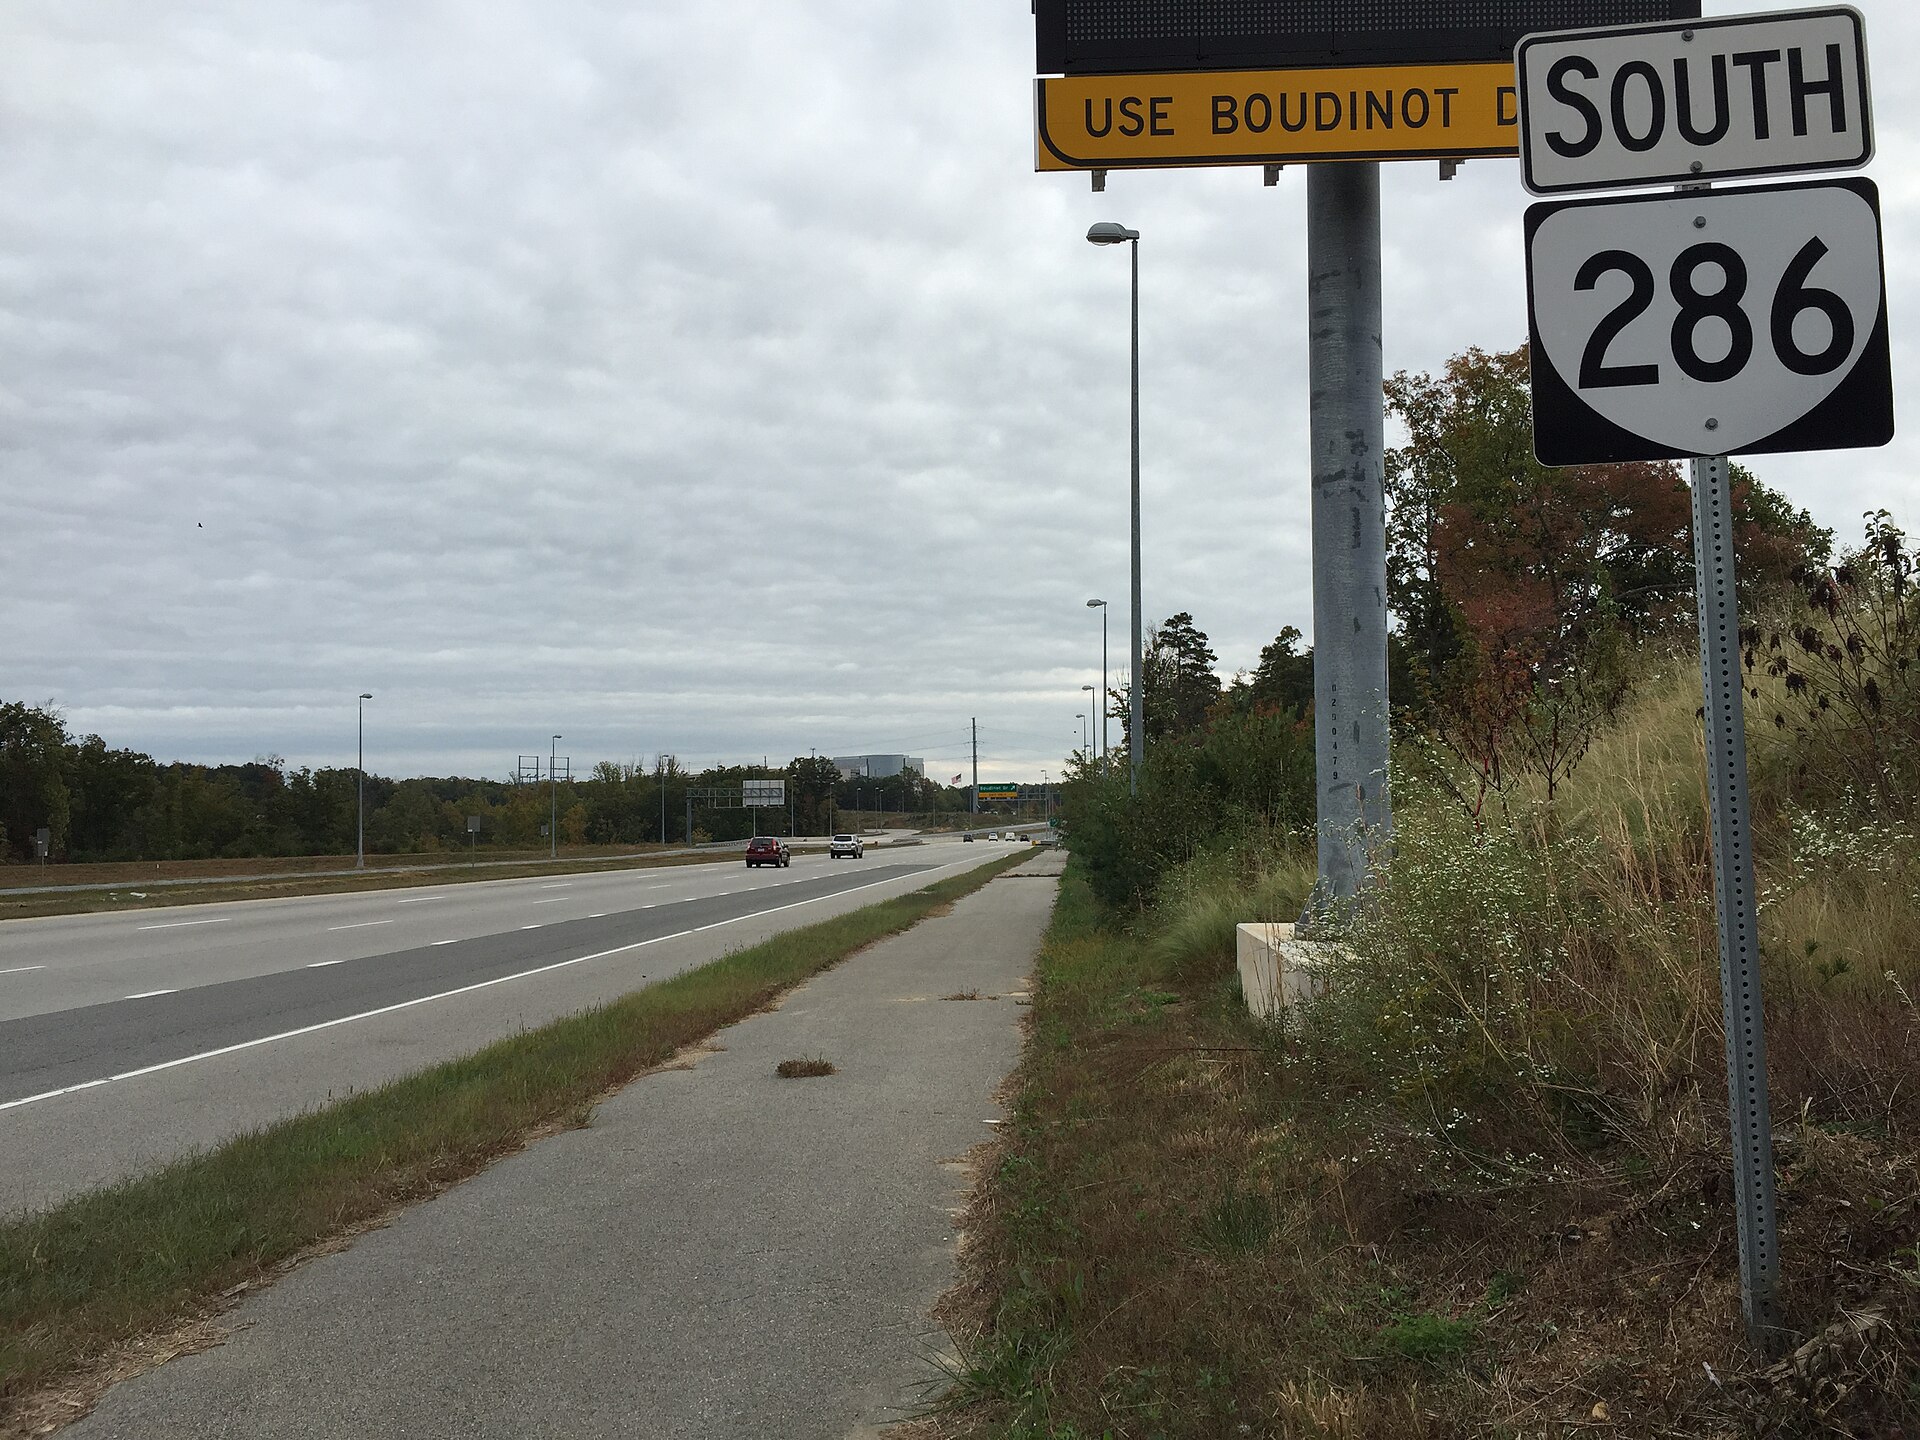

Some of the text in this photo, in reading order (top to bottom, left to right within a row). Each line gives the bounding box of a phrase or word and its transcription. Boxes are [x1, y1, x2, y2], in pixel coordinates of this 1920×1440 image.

[1084, 97, 1175, 139] USE
[1211, 87, 1460, 135] BOUDINOT
[1545, 43, 1847, 158] SOUTH
[1573, 235, 1855, 390] 286
